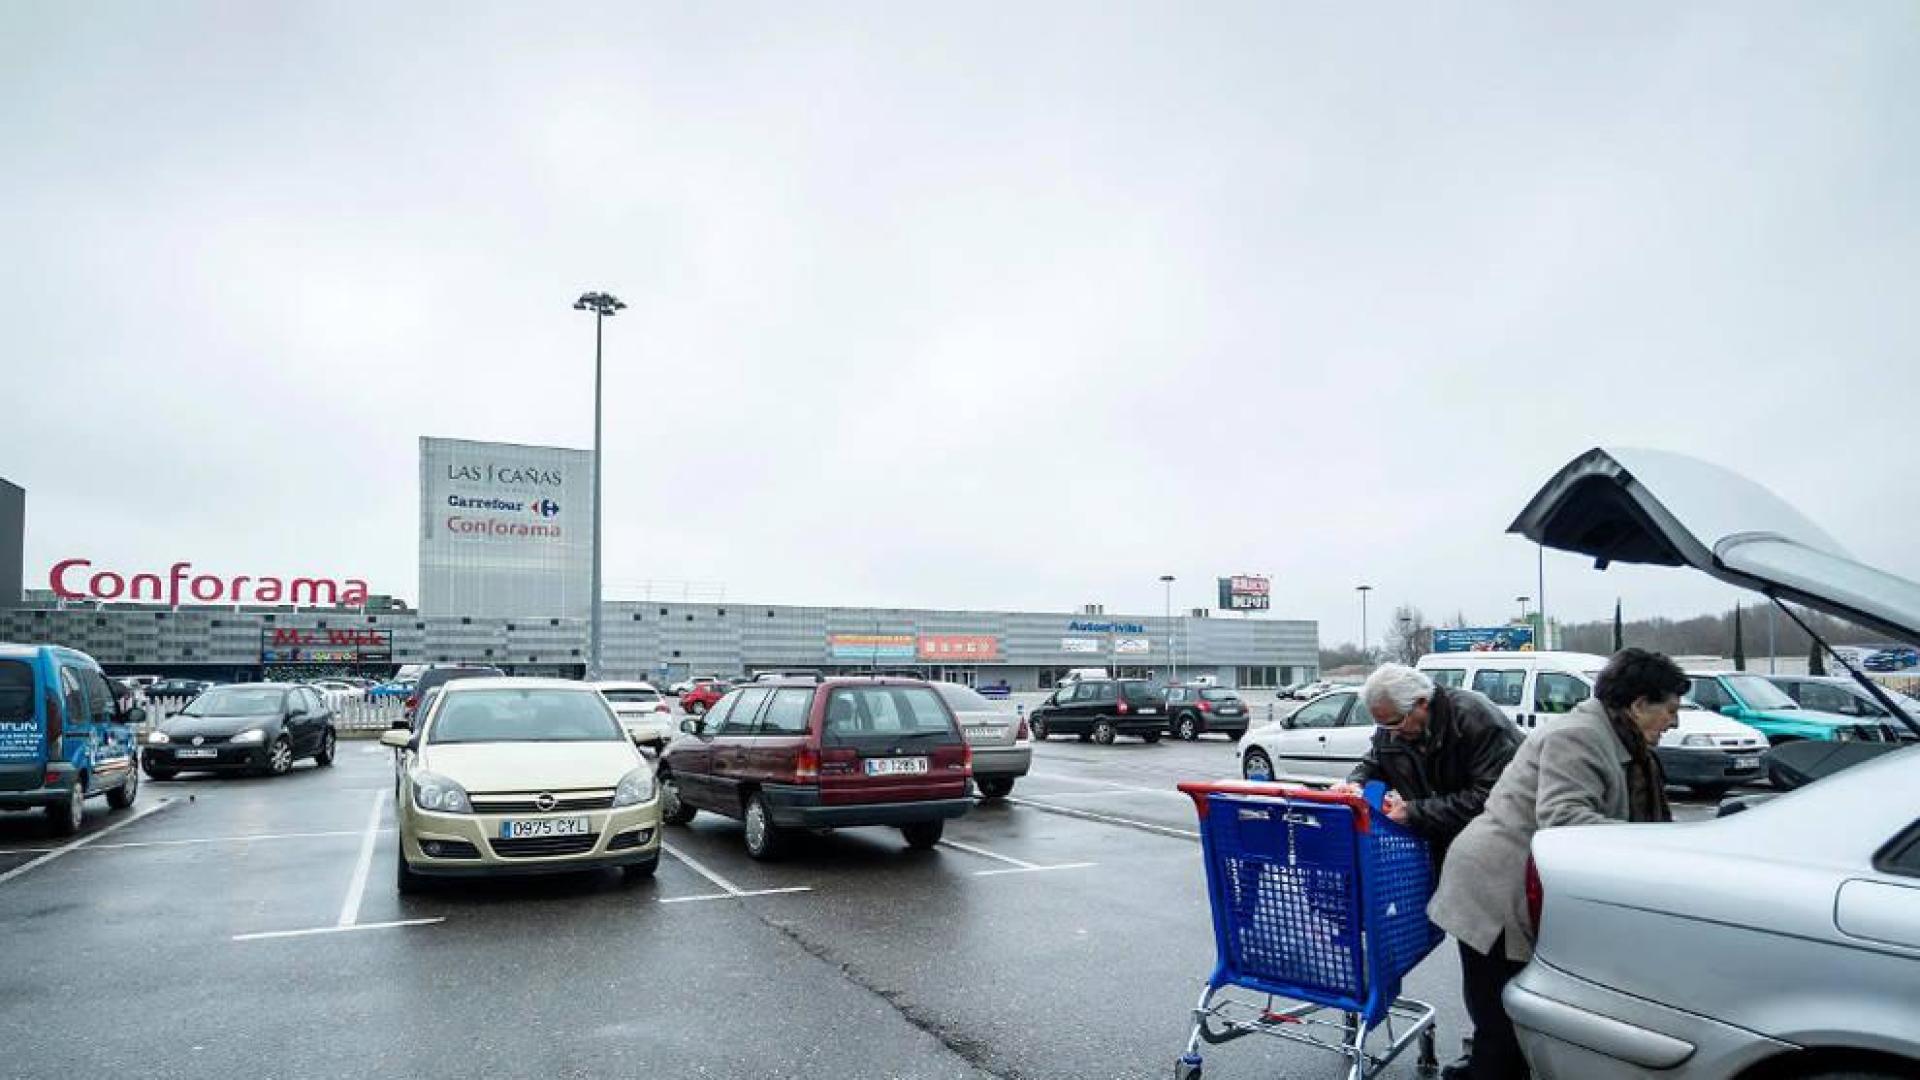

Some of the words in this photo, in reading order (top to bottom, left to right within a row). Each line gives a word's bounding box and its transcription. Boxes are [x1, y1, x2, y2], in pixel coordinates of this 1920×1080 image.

[447, 464, 481, 482] LAS
[497, 466, 562, 487] CAÑAS
[448, 495, 523, 512] Carrefour
[447, 515, 561, 538] Conforama
[49, 558, 368, 608] Conforama
[513, 821, 551, 836] 0975
[558, 818, 586, 833] CYL
